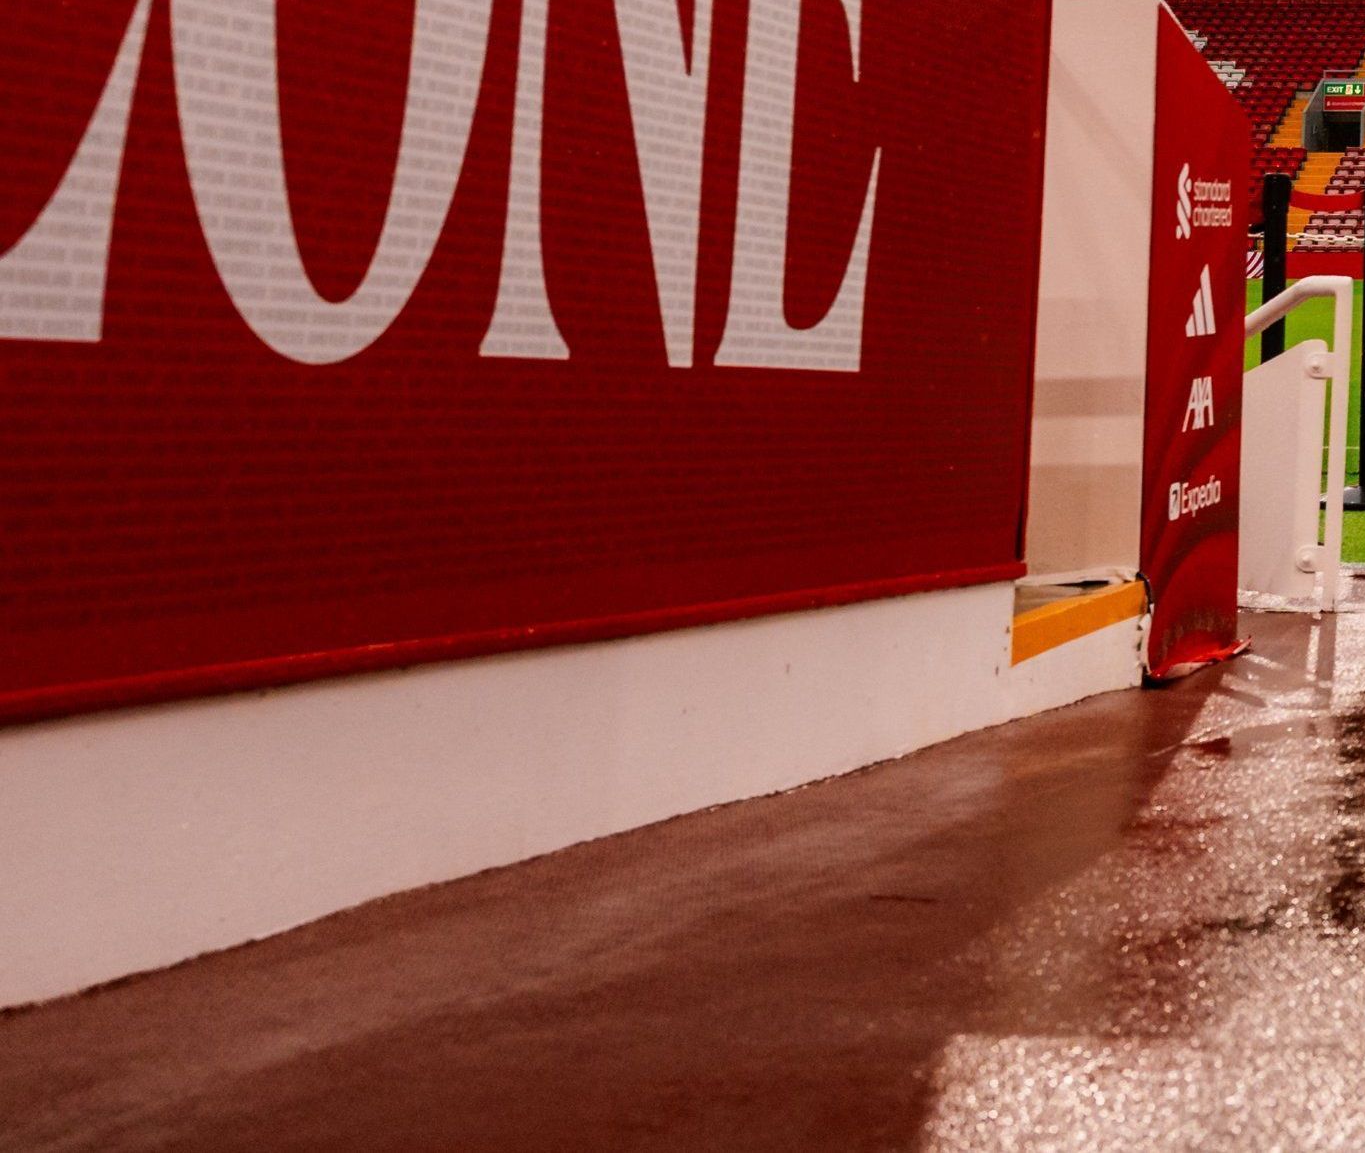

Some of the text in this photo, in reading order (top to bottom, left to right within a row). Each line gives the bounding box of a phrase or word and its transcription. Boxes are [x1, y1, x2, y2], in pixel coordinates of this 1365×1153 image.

[1193, 177, 1231, 202] standard
[1193, 203, 1232, 227] chartered
[1182, 376, 1215, 433] AXA
[1181, 475, 1221, 518] Expedia
